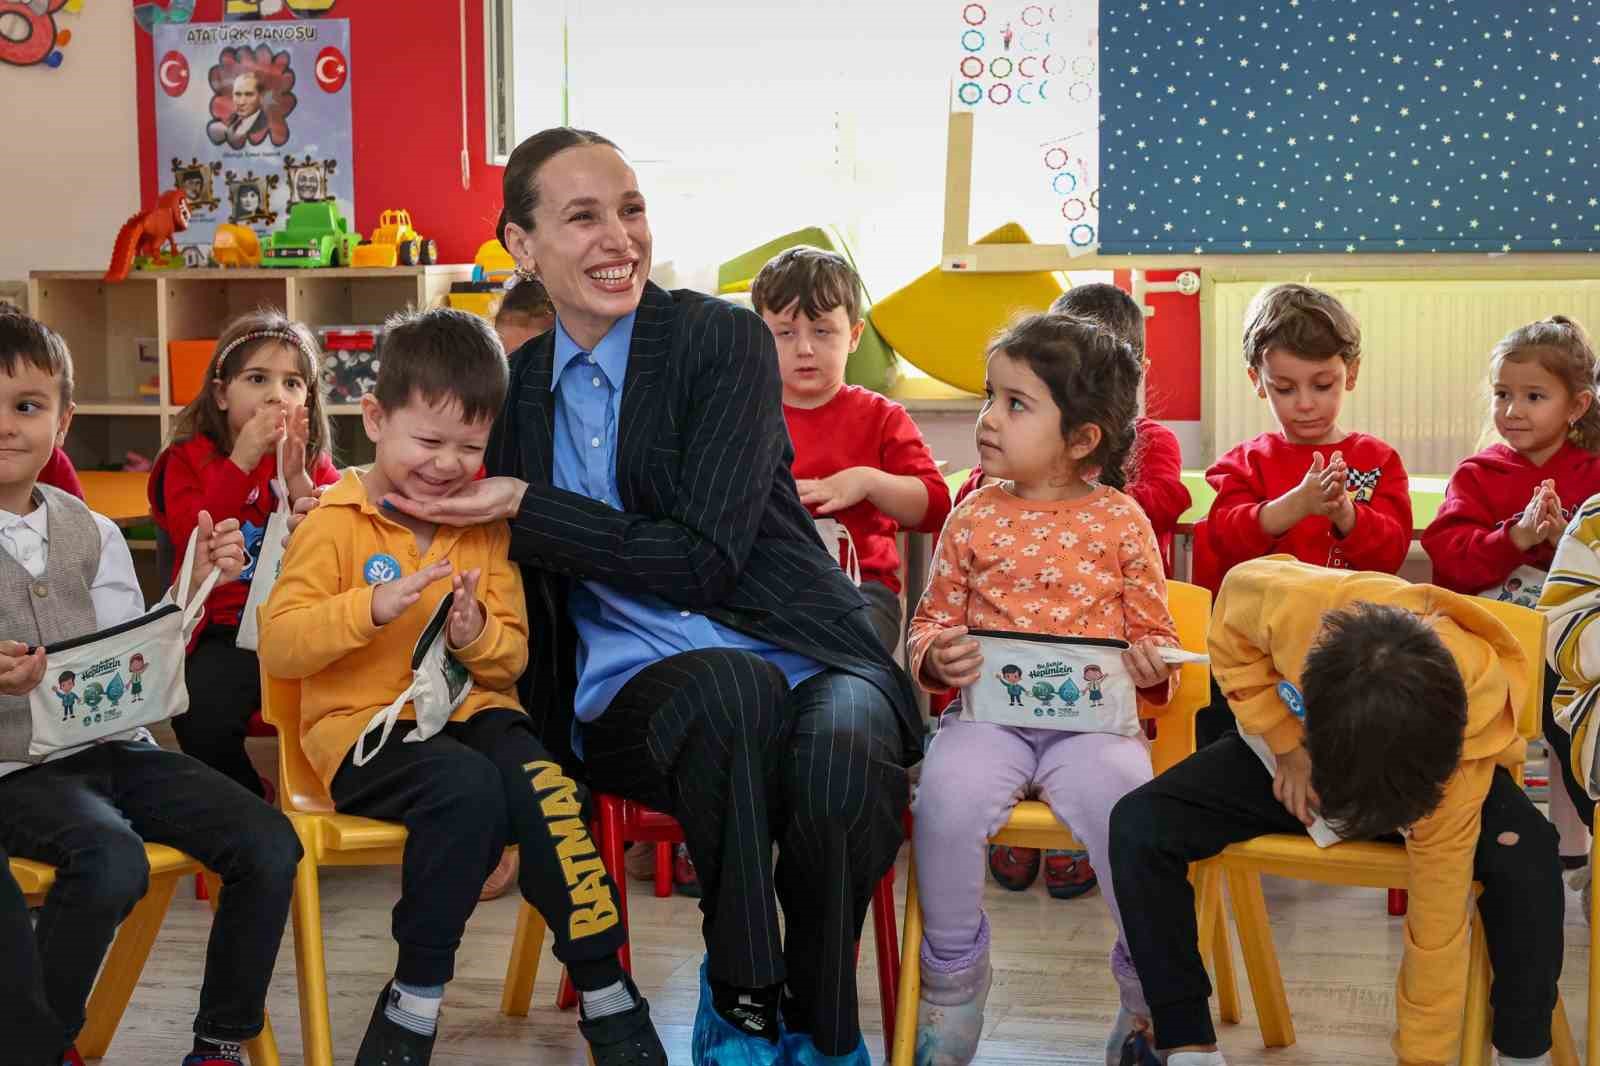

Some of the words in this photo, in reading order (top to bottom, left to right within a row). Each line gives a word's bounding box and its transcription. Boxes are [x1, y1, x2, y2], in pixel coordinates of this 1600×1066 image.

[186, 25, 251, 42] ATATÜRK
[253, 26, 316, 41] PANOSU
[1029, 664, 1073, 679] Hepimizin
[522, 760, 619, 941] BATMAN
